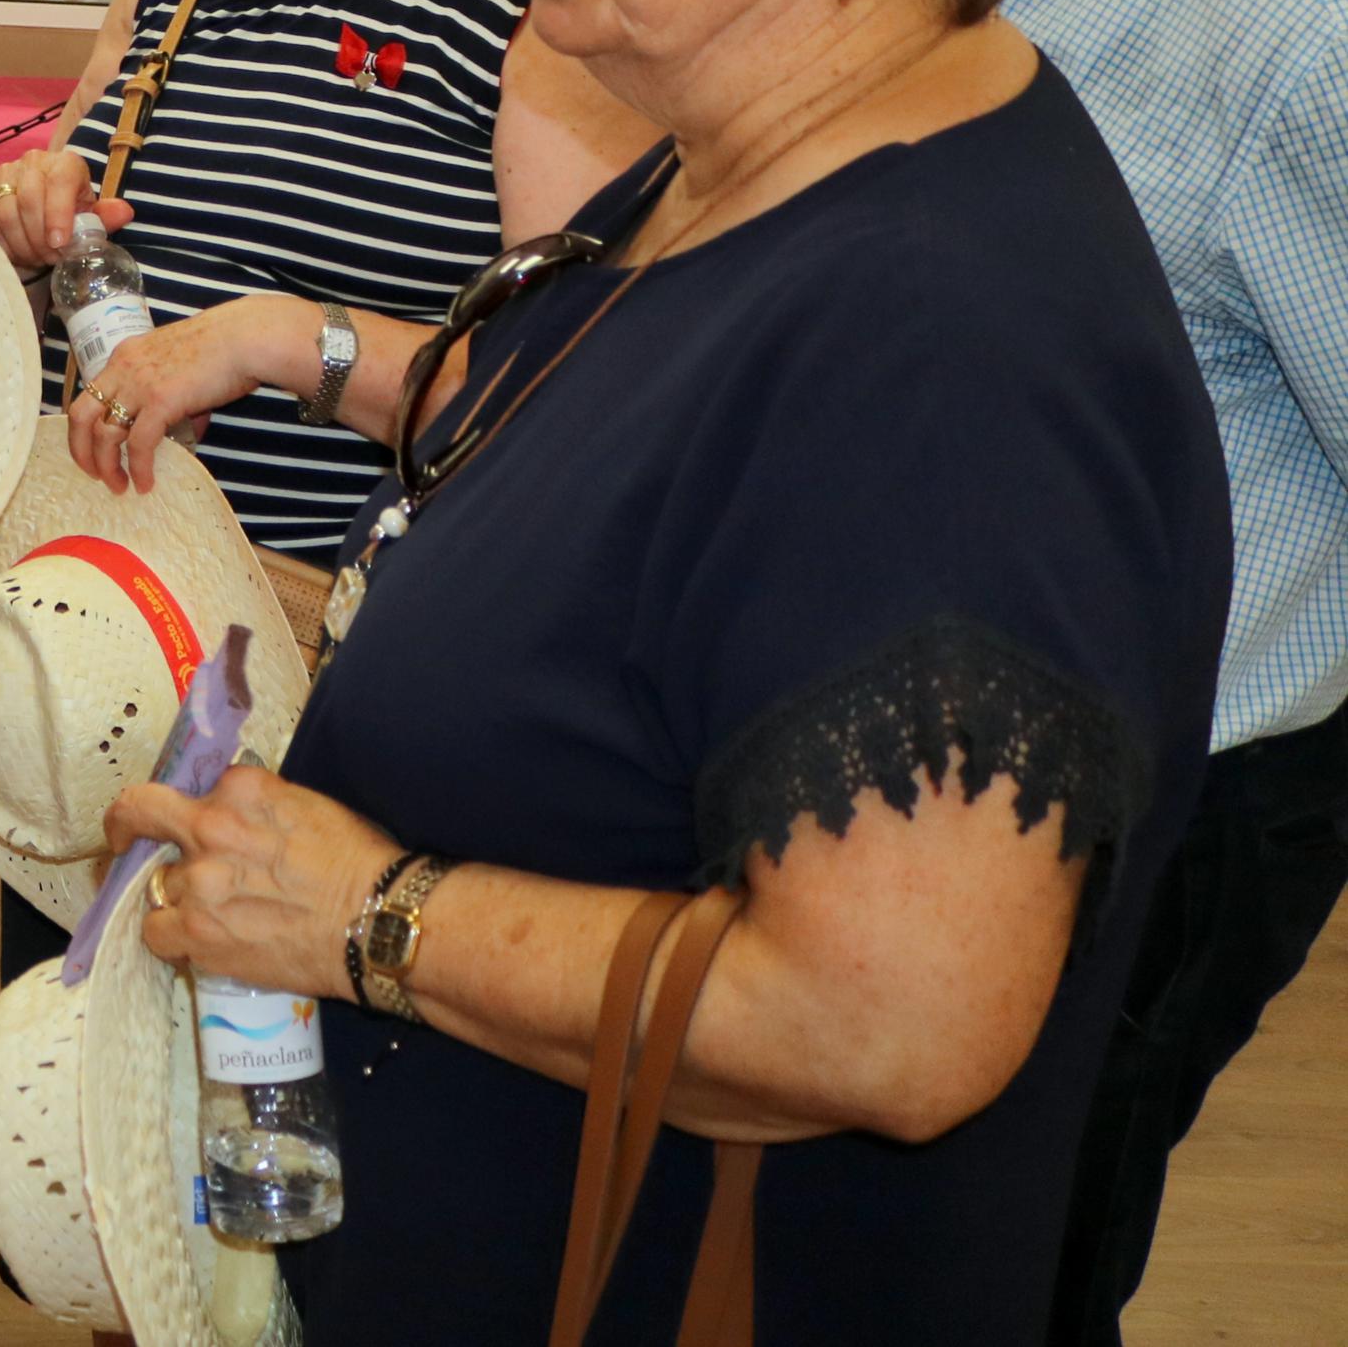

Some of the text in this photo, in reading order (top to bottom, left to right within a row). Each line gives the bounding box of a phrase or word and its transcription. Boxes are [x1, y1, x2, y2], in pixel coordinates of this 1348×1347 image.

[132, 576, 164, 614] Estado
[167, 623, 187, 660] Pacto
[218, 1044, 314, 1070] peñaclara
